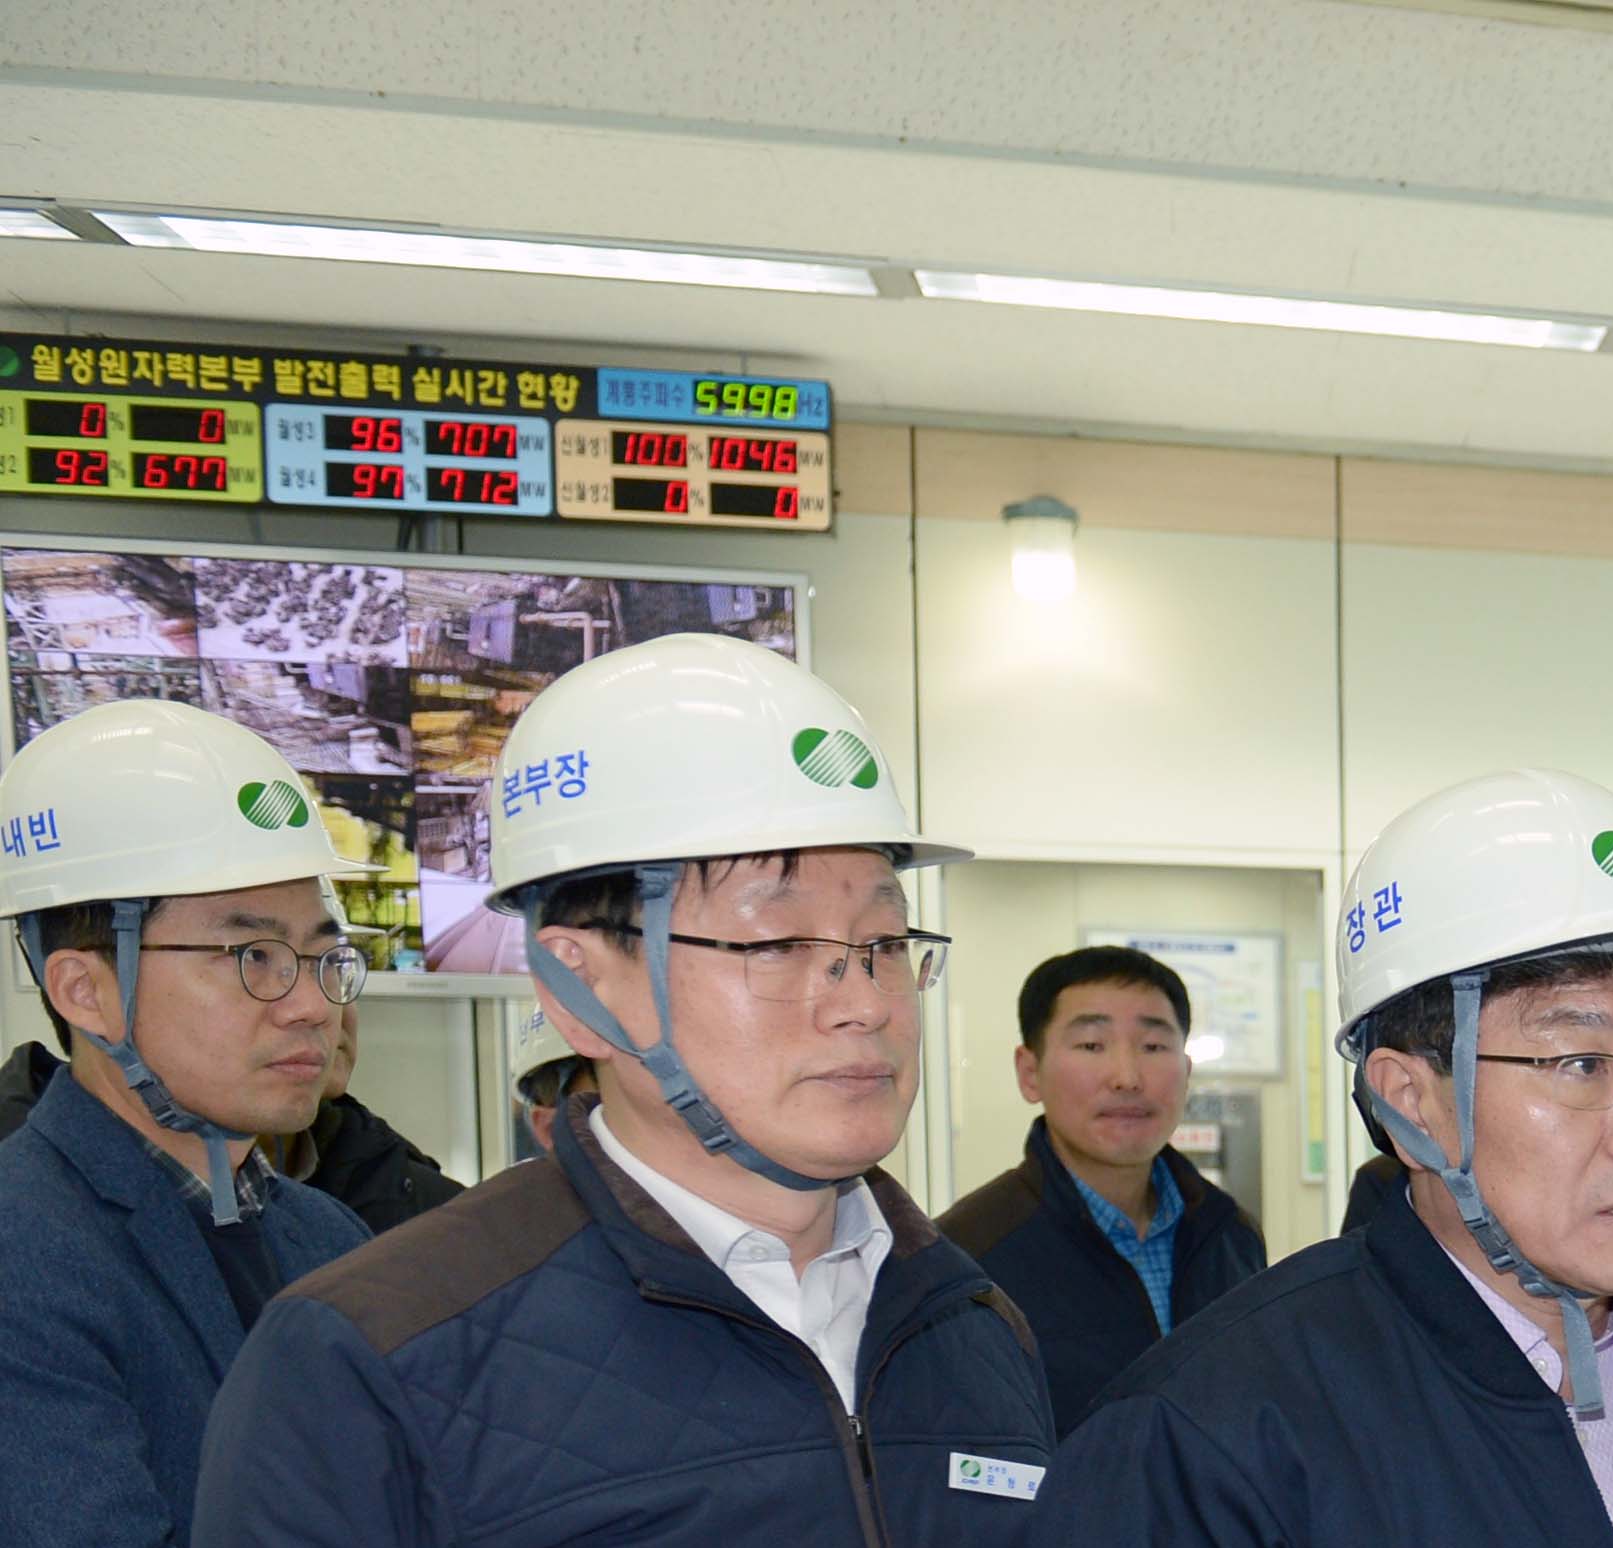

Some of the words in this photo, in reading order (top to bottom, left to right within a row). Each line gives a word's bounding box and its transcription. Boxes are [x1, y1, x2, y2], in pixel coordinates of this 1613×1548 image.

[30, 344, 263, 392] 월성원자력본부
[273, 358, 402, 401] 발전출력
[412, 366, 509, 408] 실시간
[516, 370, 581, 413] 현황
[80, 403, 107, 438] 0
[199, 408, 226, 444] 0
[351, 416, 403, 453] 96
[438, 420, 518, 459] 707
[55, 450, 109, 486] 92
[143, 453, 228, 491] 677
[624, 431, 689, 468] 100
[709, 435, 799, 474] 1046
[352, 463, 404, 499] 97
[440, 468, 519, 506] 712
[664, 479, 689, 514] 0
[774, 485, 799, 520] 0
[502, 749, 590, 819] 본부장
[1, 808, 61, 858] 내빈
[1346, 880, 1403, 954] 장관
